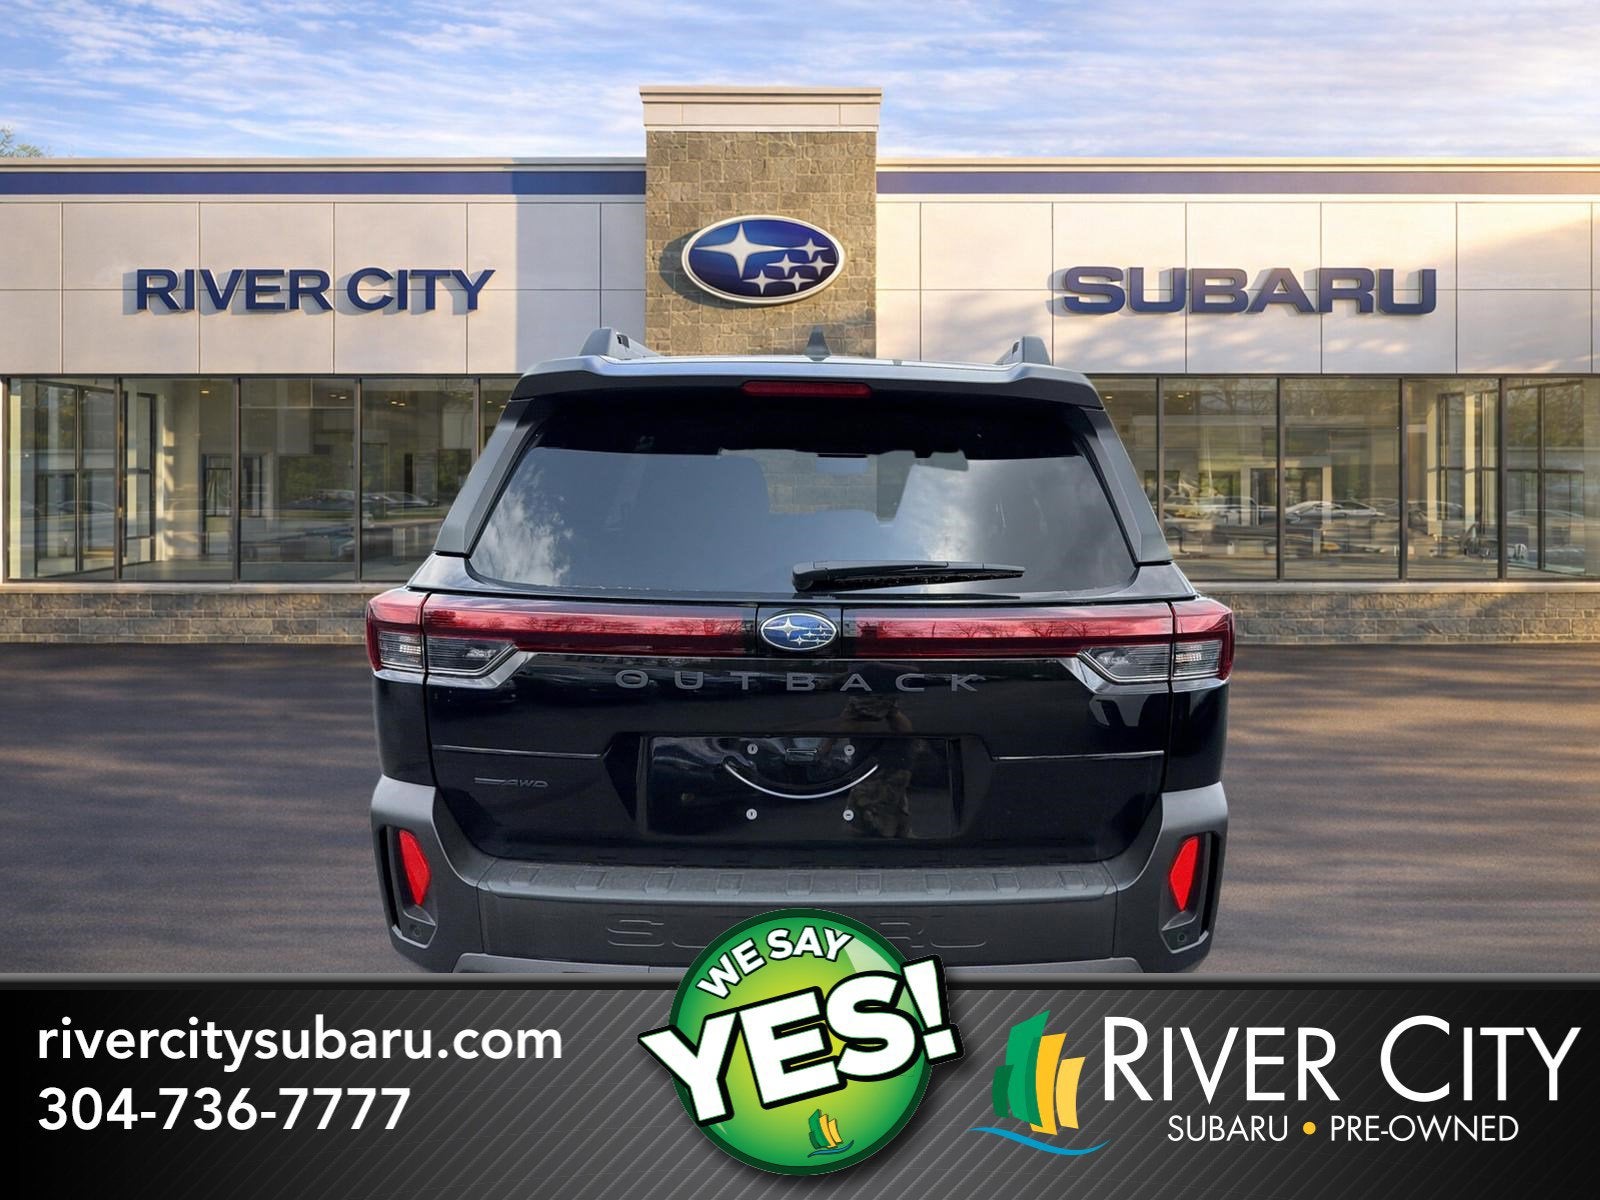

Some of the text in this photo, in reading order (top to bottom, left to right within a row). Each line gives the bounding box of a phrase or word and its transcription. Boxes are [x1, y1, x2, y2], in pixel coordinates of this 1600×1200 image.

[136, 267, 496, 311] RIVER CITY
[1063, 266, 1437, 314] SUBARU
[615, 669, 986, 692] OUTBACK
[606, 912, 988, 948] SURU
